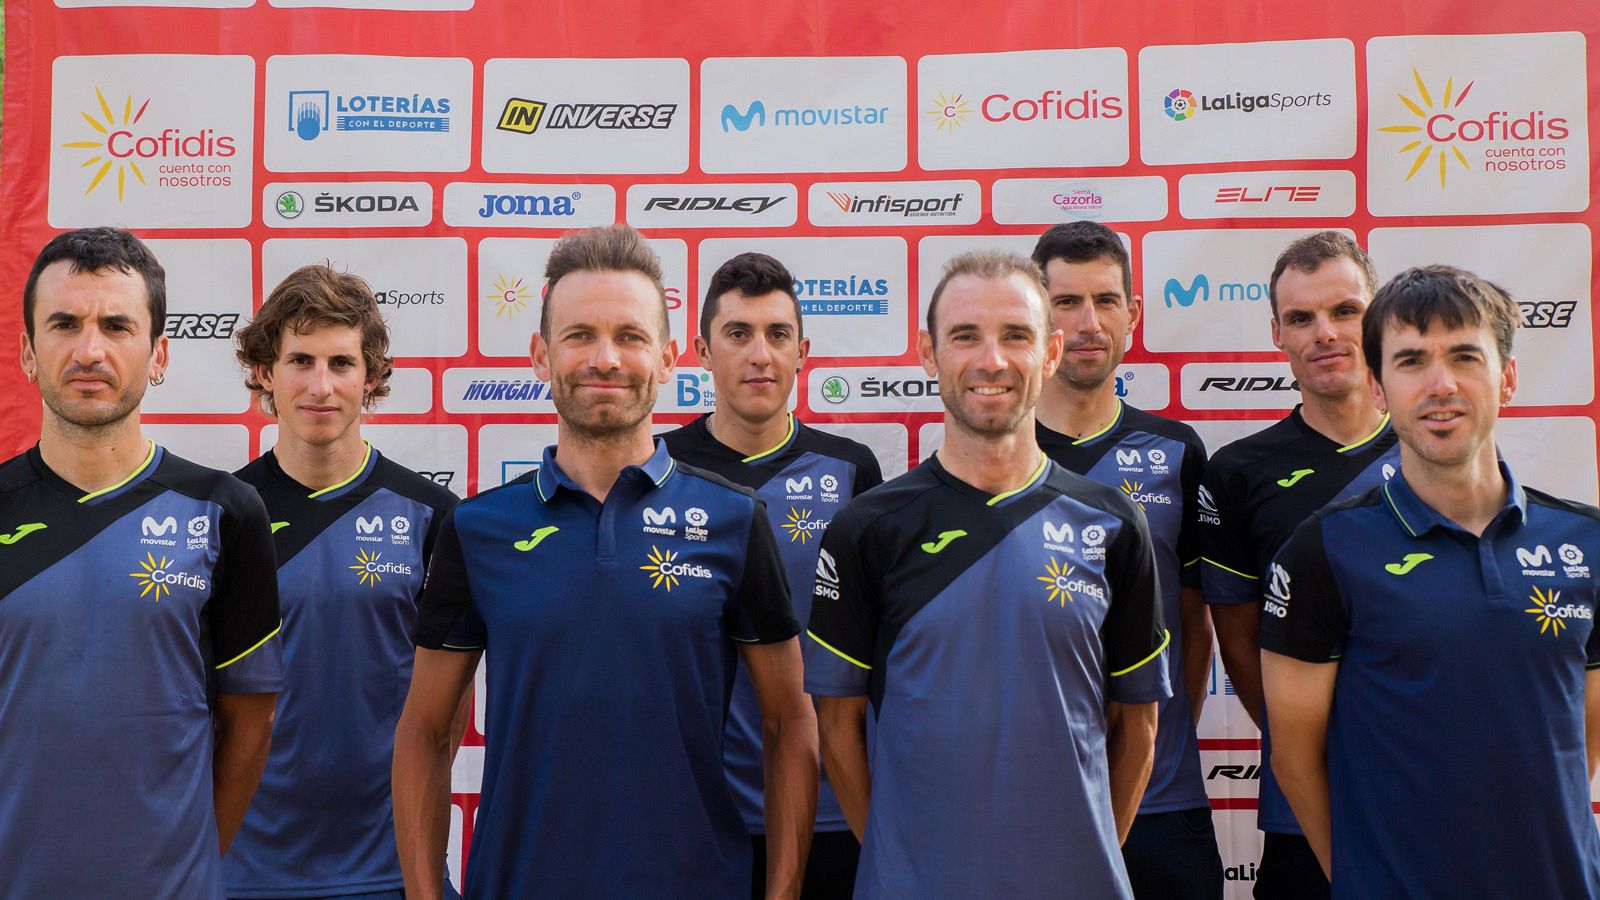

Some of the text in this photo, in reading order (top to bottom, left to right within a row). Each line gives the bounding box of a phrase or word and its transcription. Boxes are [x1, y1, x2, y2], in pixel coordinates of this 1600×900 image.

[336, 94, 451, 114] LOTERÍAS
[981, 90, 1123, 122] Cofidis
[349, 120, 436, 129] CON EL DEPORTE
[506, 104, 677, 129] IN INVERSE
[775, 105, 889, 126] movistar
[1426, 111, 1569, 142] Cofidis
[107, 129, 237, 158] Cofidis
[1485, 147, 1565, 157] cuenta con
[159, 163, 232, 173] cuenta con
[1485, 158, 1566, 171] nosotros
[159, 174, 232, 187] nosotros
[314, 192, 420, 213] ŠKODA
[643, 196, 788, 214] RIDLEY
[851, 193, 963, 217] infisport
[1053, 193, 1102, 205] Cazorla
[793, 275, 889, 296] OTERÍAS
[812, 304, 823, 312] EL
[827, 304, 874, 312] DEPORTE
[164, 314, 240, 339] ERSE
[462, 380, 545, 401] MORGAN
[861, 377, 941, 398] ŠKOD
[1199, 377, 1300, 391] RIDL
[1130, 492, 1172, 505] Cofidis
[643, 526, 676, 536] movistar
[797, 520, 831, 530] Cofi
[140, 538, 177, 546] movistar
[366, 562, 411, 575] Cofidis
[660, 562, 712, 578] Cofidis
[152, 569, 206, 590] Cofidis
[1056, 575, 1104, 599] Cofidis
